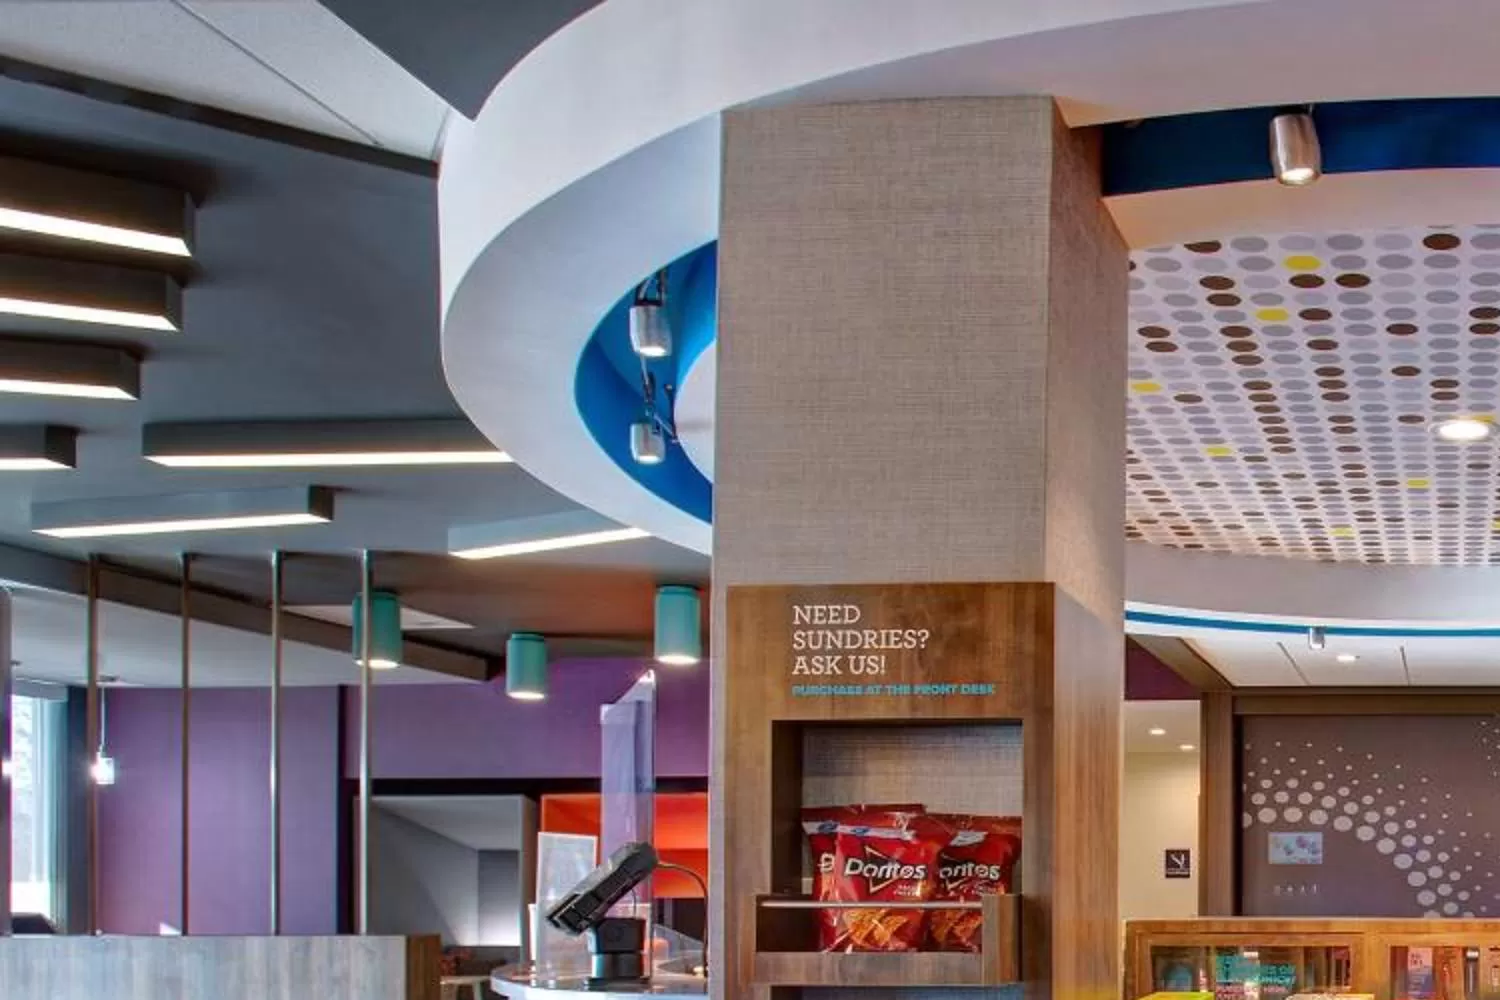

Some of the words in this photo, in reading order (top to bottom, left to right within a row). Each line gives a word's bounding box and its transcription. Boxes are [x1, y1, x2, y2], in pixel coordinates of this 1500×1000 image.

[792, 605, 861, 625] NEED
[792, 629, 929, 650] SUNDRIES?
[792, 655, 843, 675] ASK
[849, 655, 886, 675] US!
[844, 857, 928, 880] Doritos
[939, 861, 1001, 881] oritos
